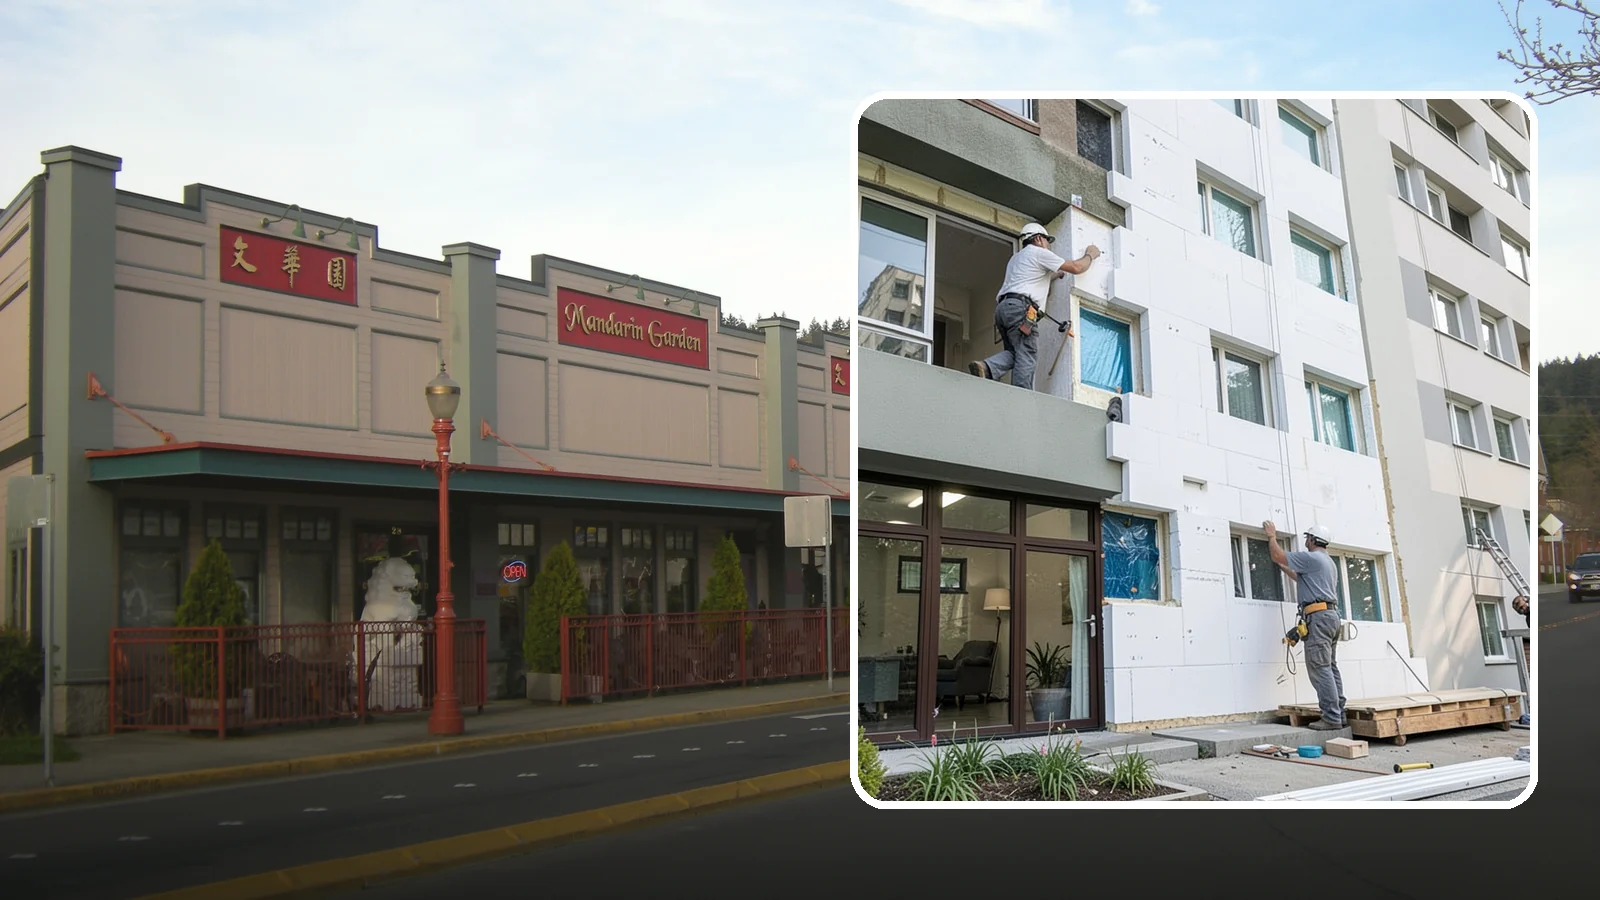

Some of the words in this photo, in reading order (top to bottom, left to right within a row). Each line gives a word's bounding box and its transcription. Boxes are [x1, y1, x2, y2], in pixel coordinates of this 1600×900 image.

[231, 236, 346, 290] 文華園
[564, 303, 644, 341] Mandarin
[647, 320, 702, 352] Garden
[503, 565, 527, 578] OPEN
